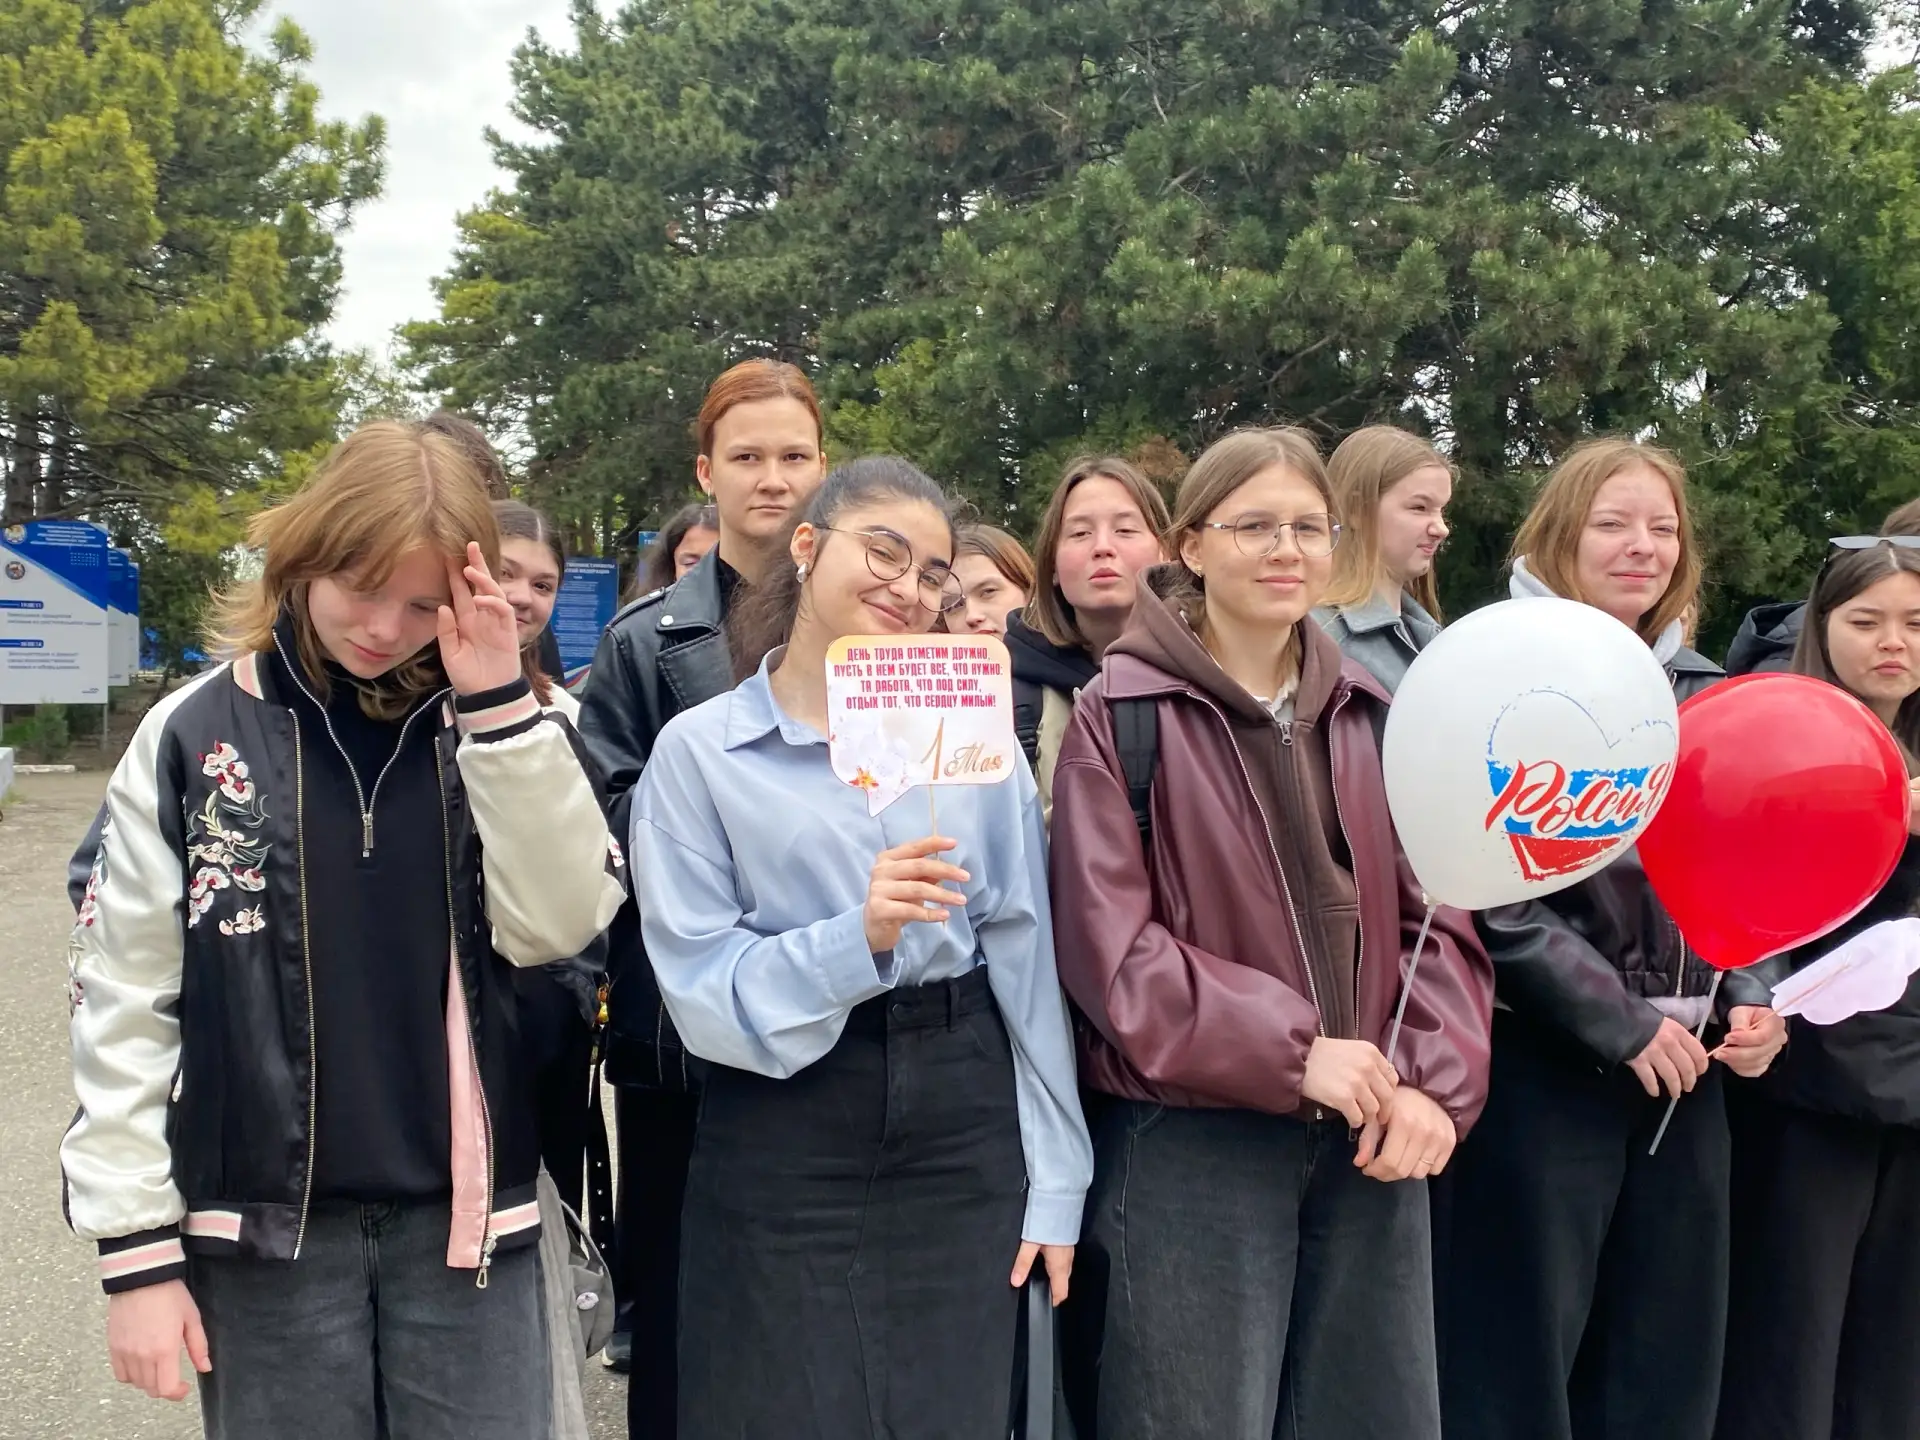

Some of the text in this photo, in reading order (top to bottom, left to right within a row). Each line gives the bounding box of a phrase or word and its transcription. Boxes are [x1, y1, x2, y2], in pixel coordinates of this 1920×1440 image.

[847, 647, 991, 662] ДЕНЬ ТРУДА ОТМЕТИМ ДРУЖНО,
[834, 663, 1003, 677] ПУСТЬ В НЕМ БУДЕТ ВСЕ, ЧТО НУЖНО:
[860, 679, 982, 693] ТА РАБОТА, ЧТО ПОД СИЛУ,
[846, 693, 996, 710] ОТДЫХ ТОТ, ЧТО СЕРДЦУ МИЛЫЙ!
[920, 716, 1003, 780] 1 Мая
